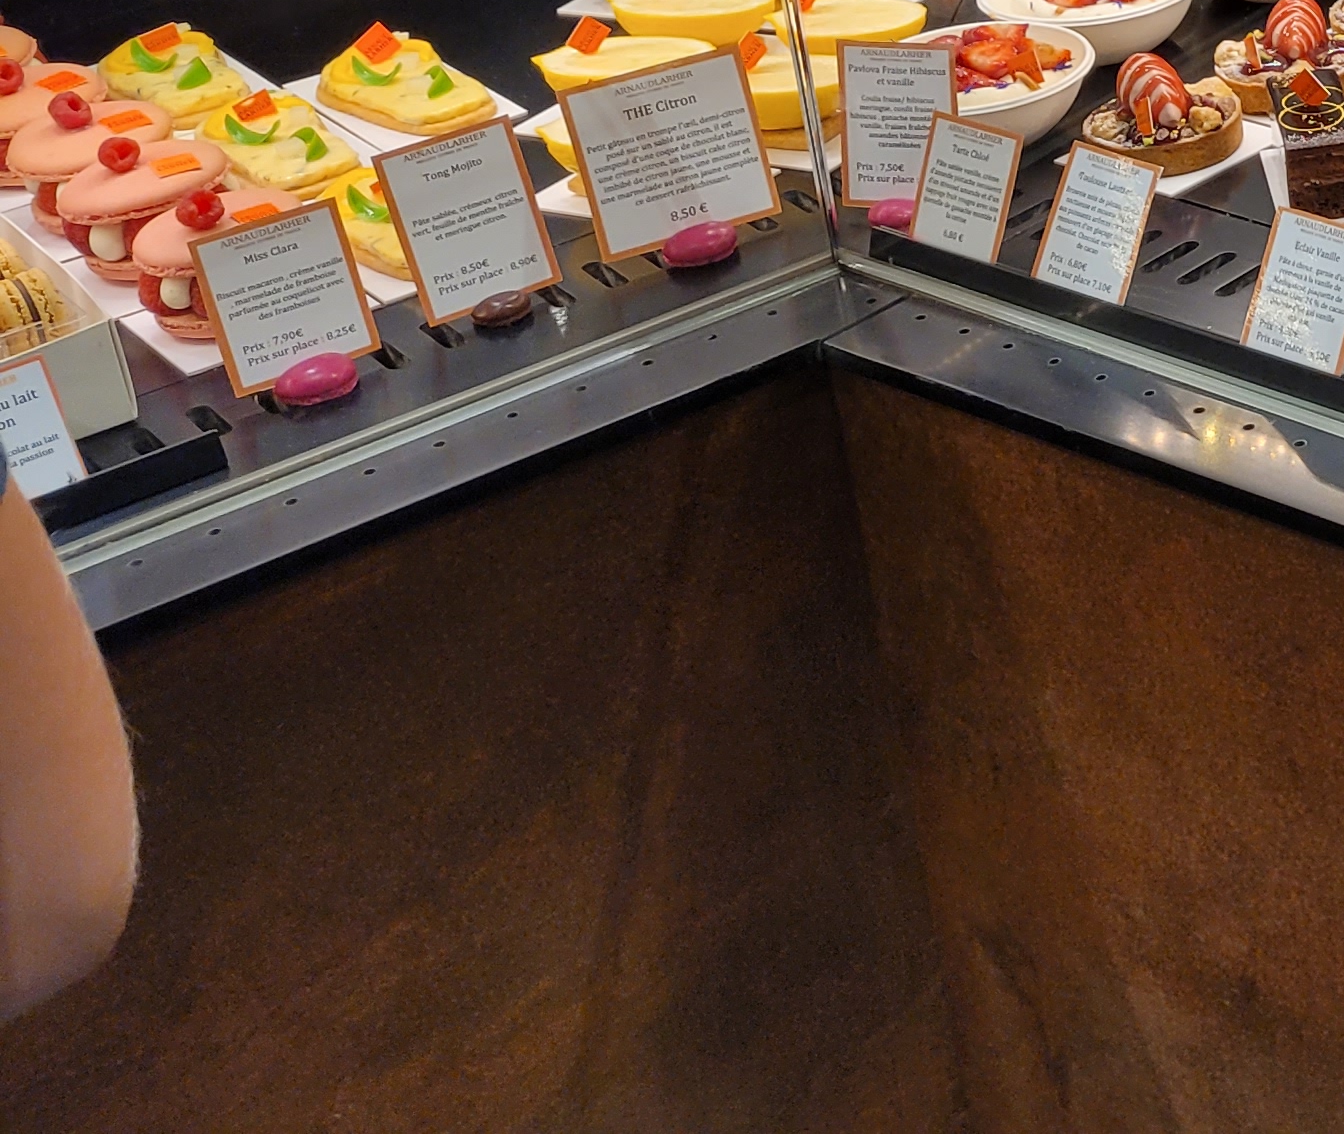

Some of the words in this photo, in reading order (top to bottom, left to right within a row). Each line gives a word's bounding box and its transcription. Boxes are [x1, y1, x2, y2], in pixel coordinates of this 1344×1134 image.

[623, 104, 653, 121] THE
[656, 94, 697, 112] Citron
[423, 169, 450, 182] Tong
[452, 157, 482, 174] Mojito
[670, 204, 696, 222] 8,50
[699, 202, 709, 214] €
[243, 252, 268, 265] Miss
[270, 242, 298, 256] Clara
